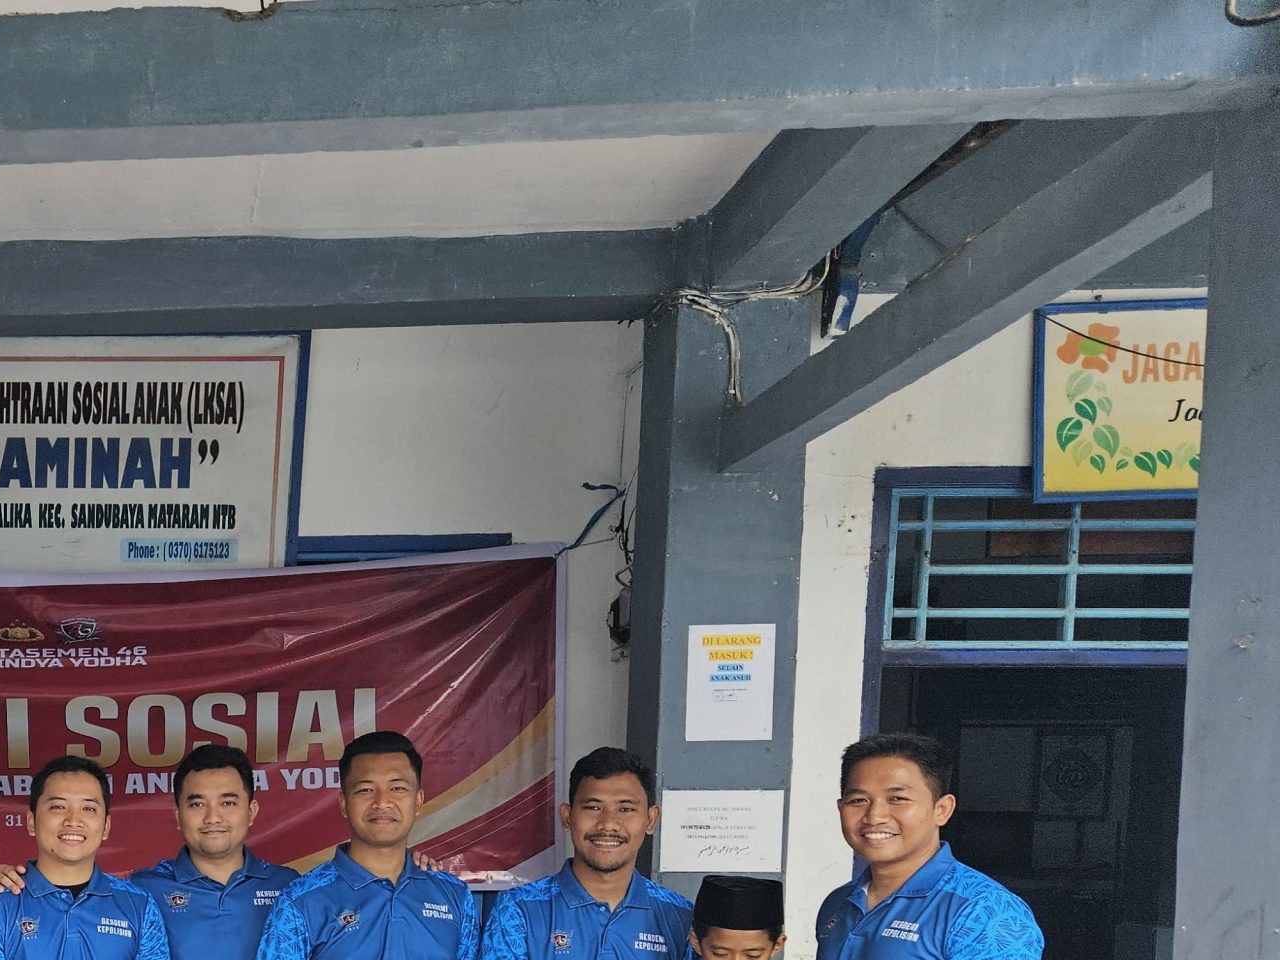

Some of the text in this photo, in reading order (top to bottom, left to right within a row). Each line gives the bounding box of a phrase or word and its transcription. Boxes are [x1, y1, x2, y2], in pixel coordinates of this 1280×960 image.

[71, 381, 130, 425] SOSIAL
[132, 381, 184, 425] ANAK
[187, 381, 245, 434] (LKSA)
[1168, 399, 1202, 422] Ja
[70, 503, 145, 530] SANDUBAYA
[147, 503, 210, 530] MATARAM
[212, 504, 237, 530] NTB
[193, 541, 230, 559] 6175123
[117, 645, 148, 656] 46
[709, 651, 747, 661] MASUK
[69, 655, 148, 668] YODHA
[717, 664, 744, 672] SELAIN
[280, 768, 342, 790] YOD
[5, 814, 23, 828] 31
